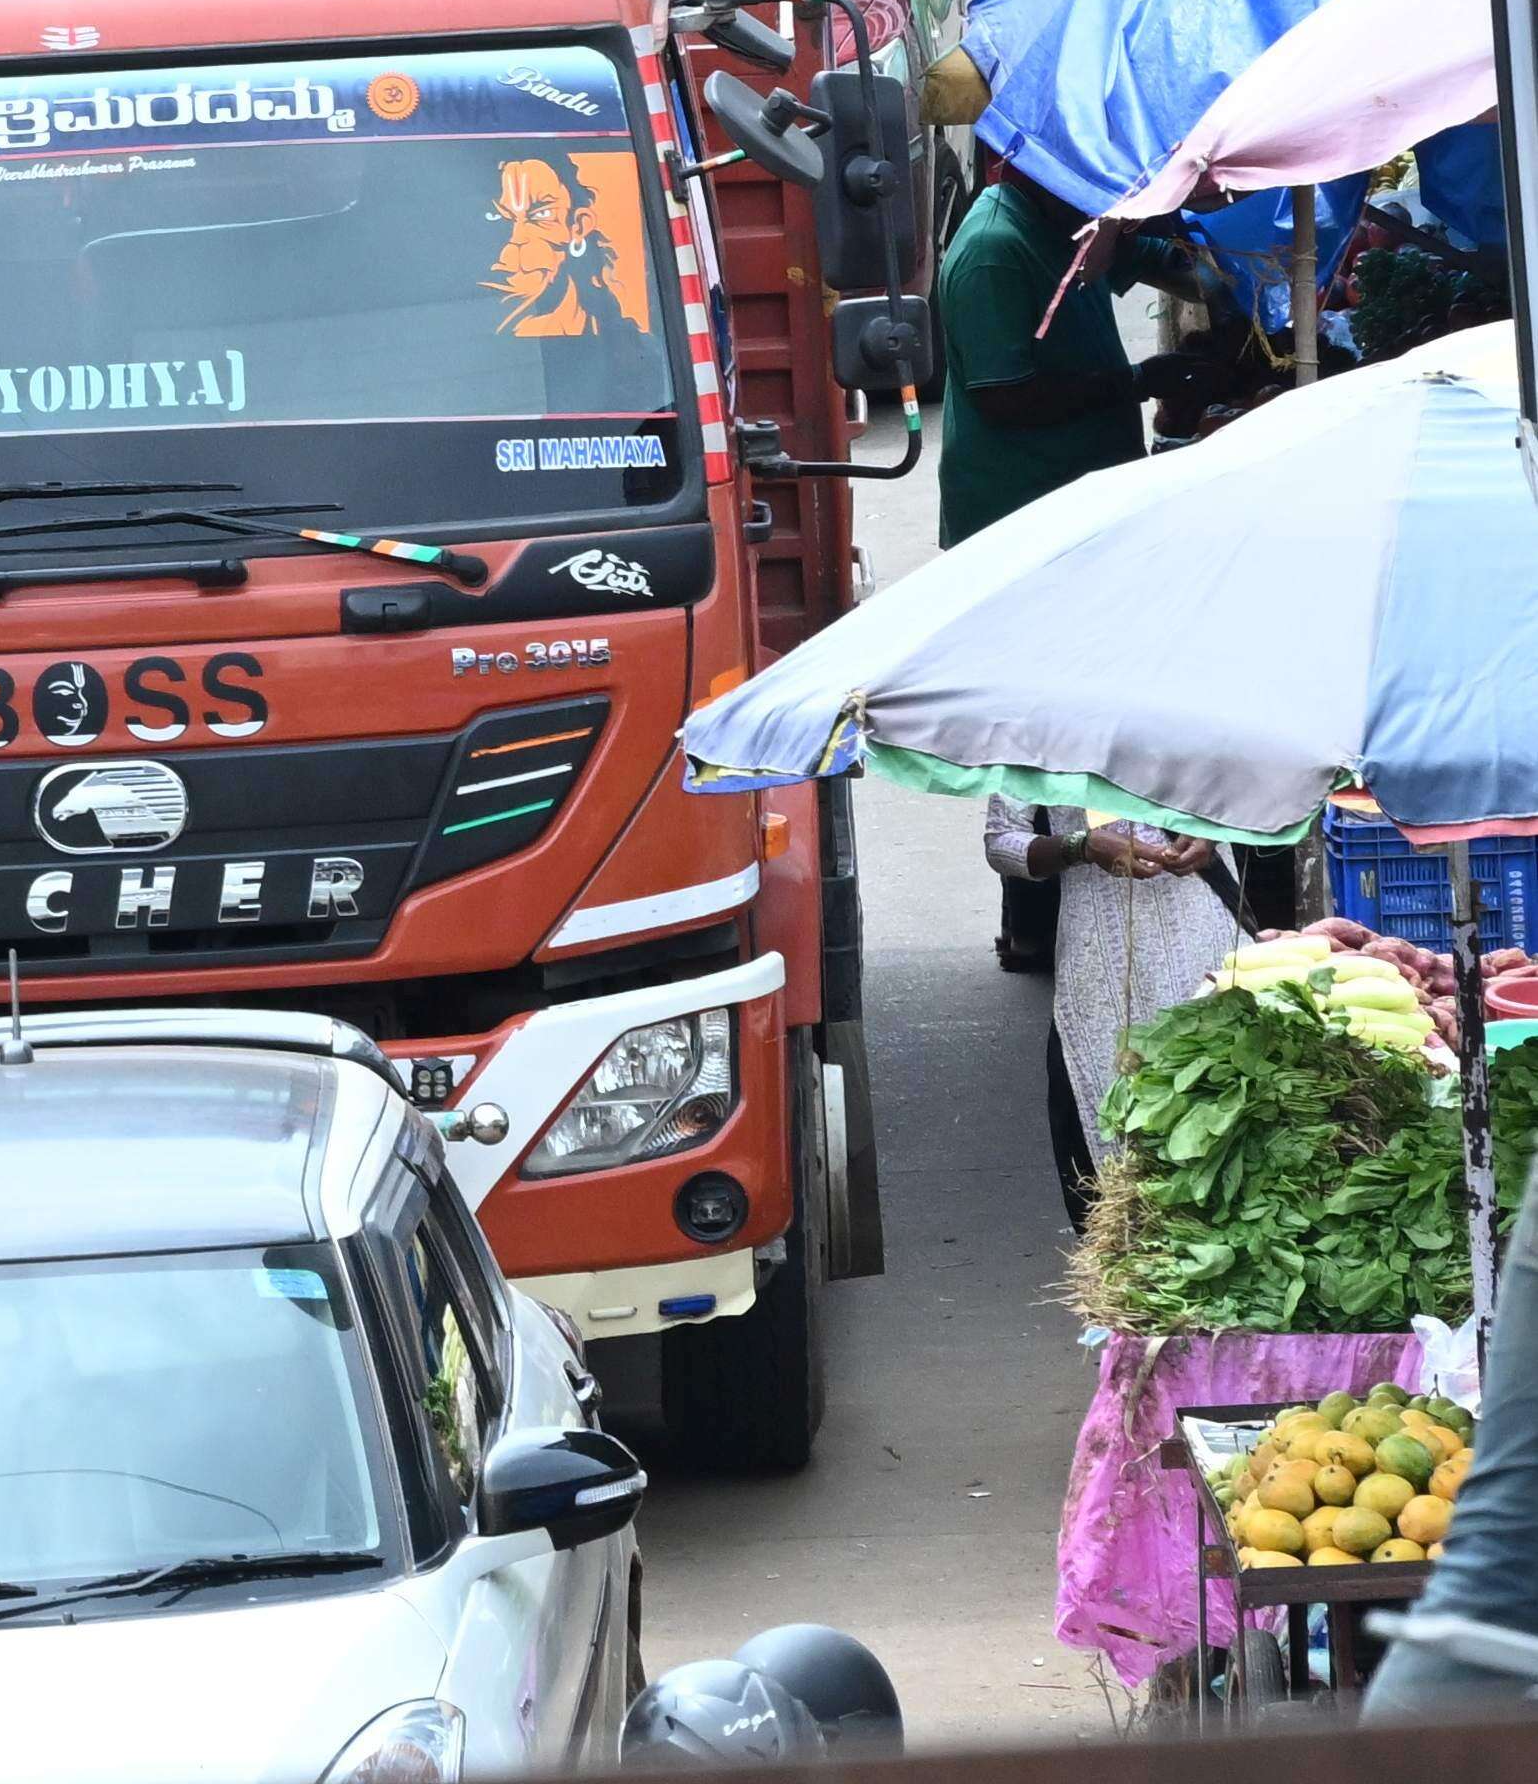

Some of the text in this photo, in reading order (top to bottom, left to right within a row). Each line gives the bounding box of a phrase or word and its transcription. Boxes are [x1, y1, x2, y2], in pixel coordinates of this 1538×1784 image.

[497, 62, 604, 118] Bindu
[495, 435, 668, 473] SRI MAHAMAYA
[452, 637, 612, 678] Pro 3015
